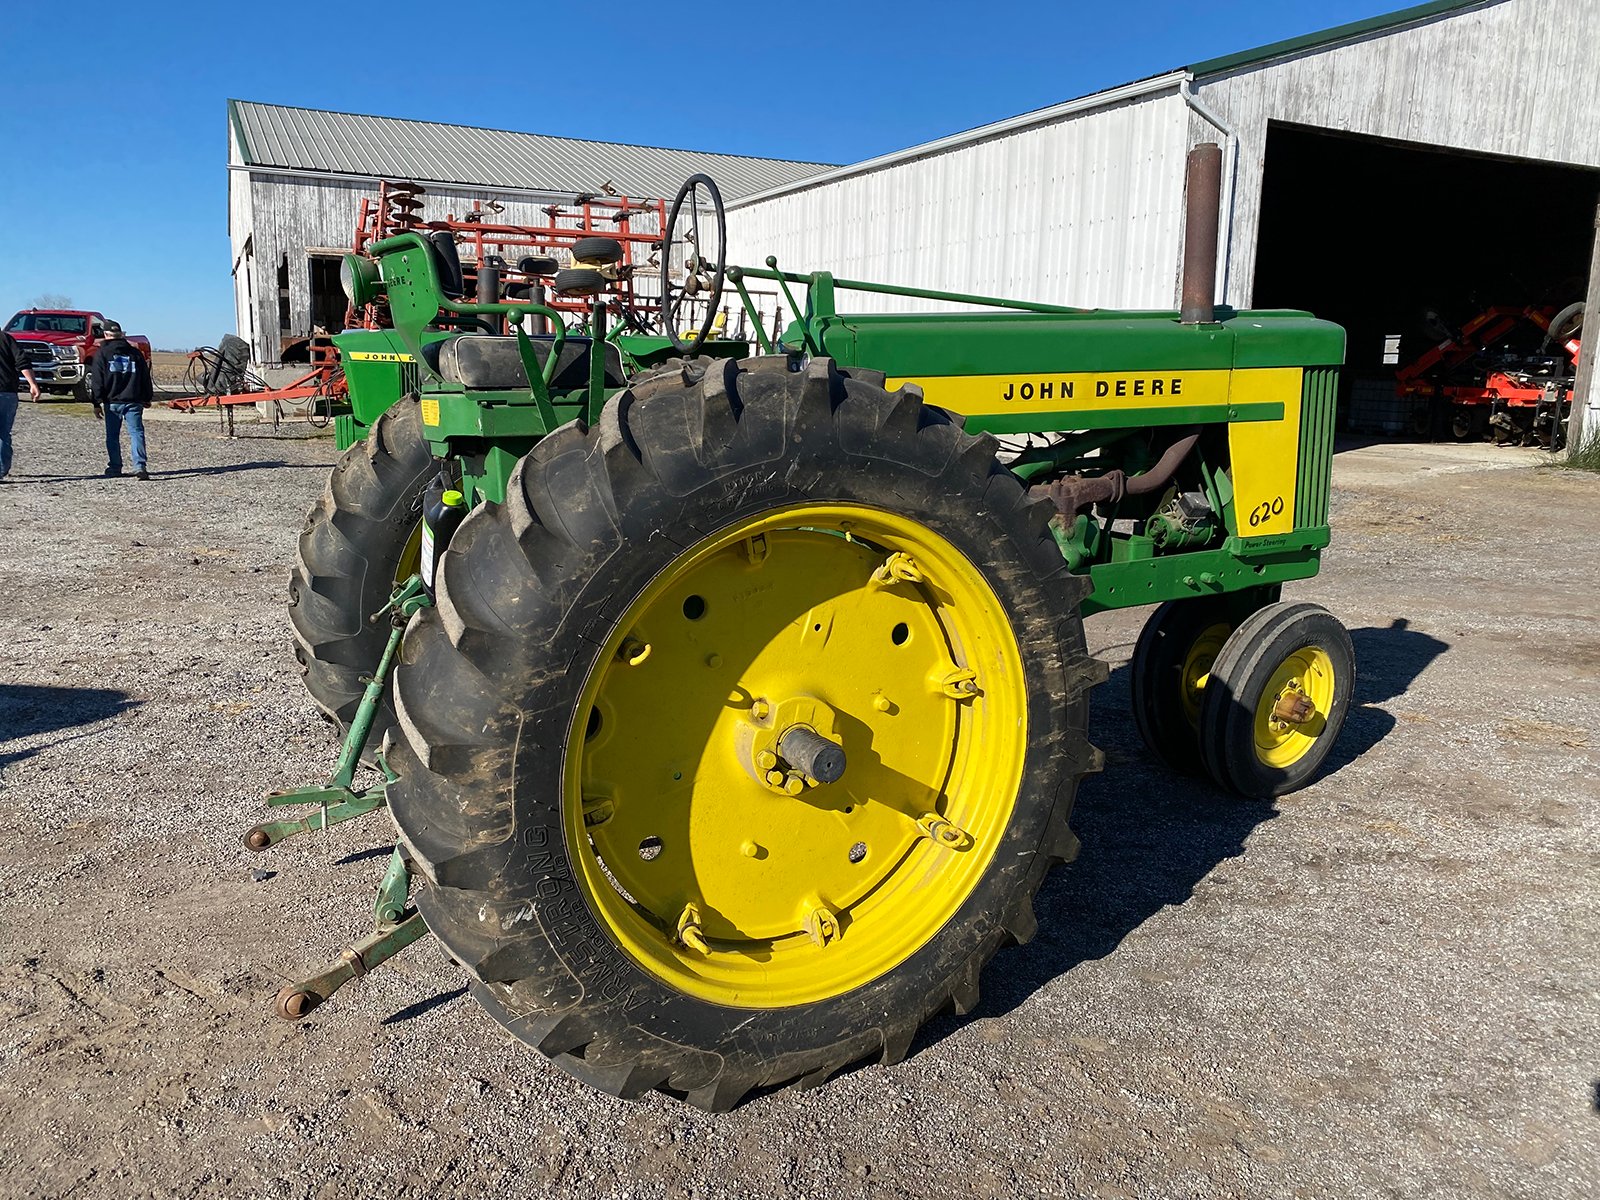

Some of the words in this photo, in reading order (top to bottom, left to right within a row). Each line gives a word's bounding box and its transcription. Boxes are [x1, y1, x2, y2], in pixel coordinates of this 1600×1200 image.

[1003, 382, 1074, 400] JOHN
[1095, 379, 1182, 397] DEERE
[1249, 496, 1284, 527] 620
[1244, 540, 1262, 549] Power
[1262, 538, 1287, 547] Steering
[523, 825, 650, 1013] ARMSTRONG
